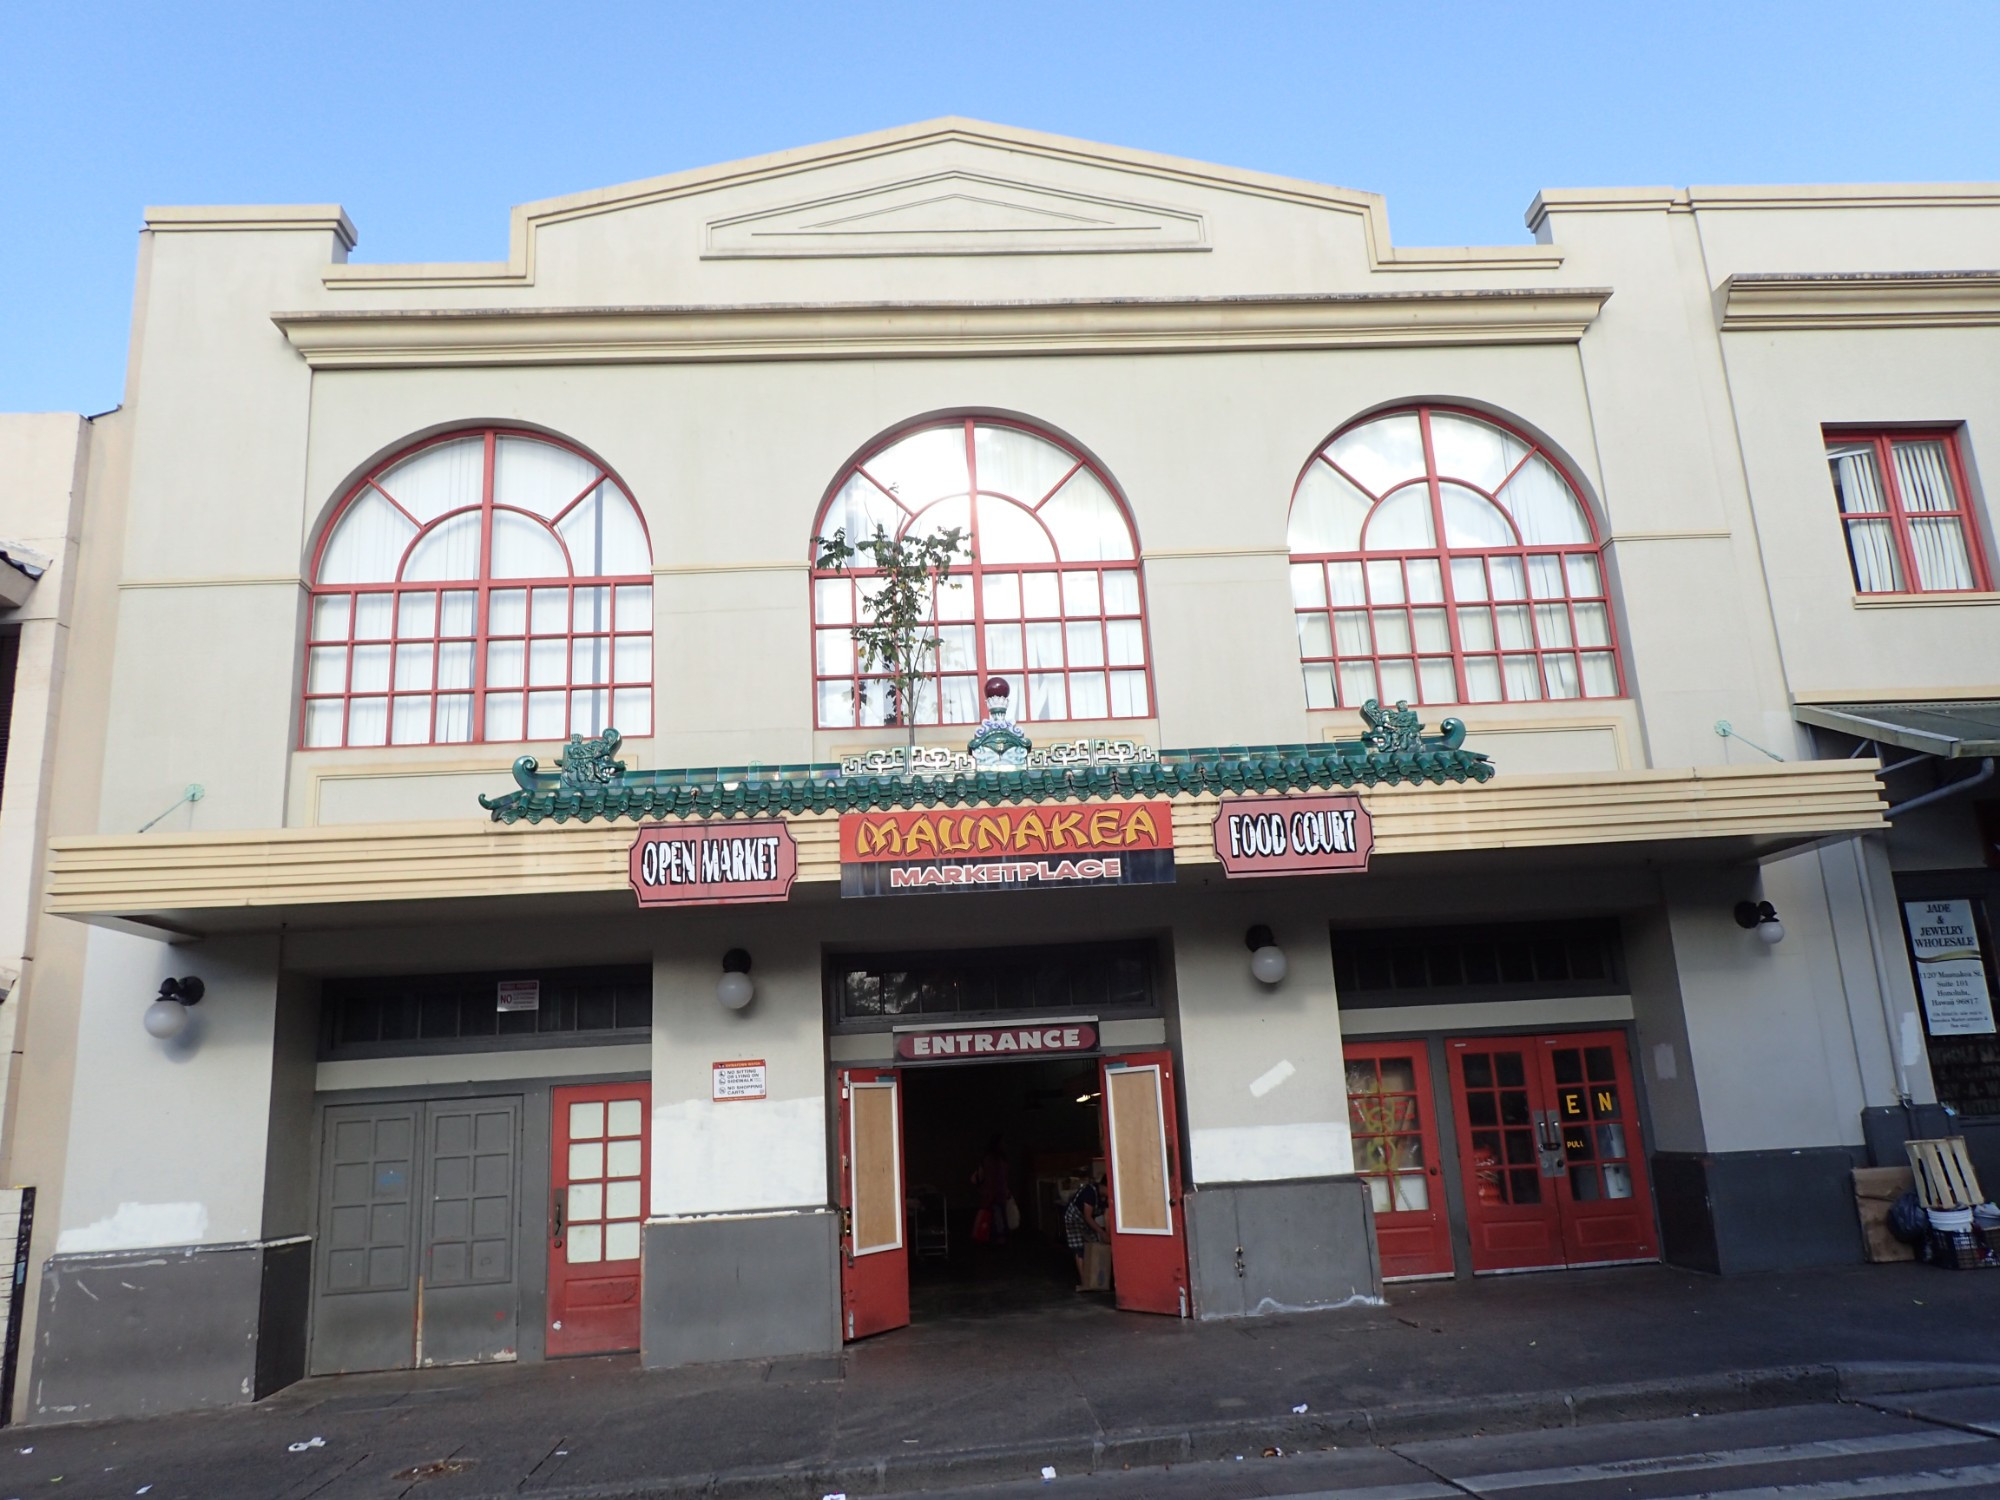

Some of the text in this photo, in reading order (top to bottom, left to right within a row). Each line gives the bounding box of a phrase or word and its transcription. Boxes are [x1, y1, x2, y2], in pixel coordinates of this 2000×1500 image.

[855, 804, 1159, 857] MAUNAKEA
[1229, 809, 1356, 857] FOOD COURT
[642, 837, 779, 886] OPEN MARKET
[890, 858, 1122, 887] MARKETPLACE
[1926, 903, 1952, 914] JADE
[1936, 915, 1945, 925] &
[1920, 925, 1964, 937] JEWELRY
[1914, 937, 1975, 949] WHOLESALE
[501, 995, 512, 1004] NO
[913, 1028, 1081, 1056] ENTRANCE
